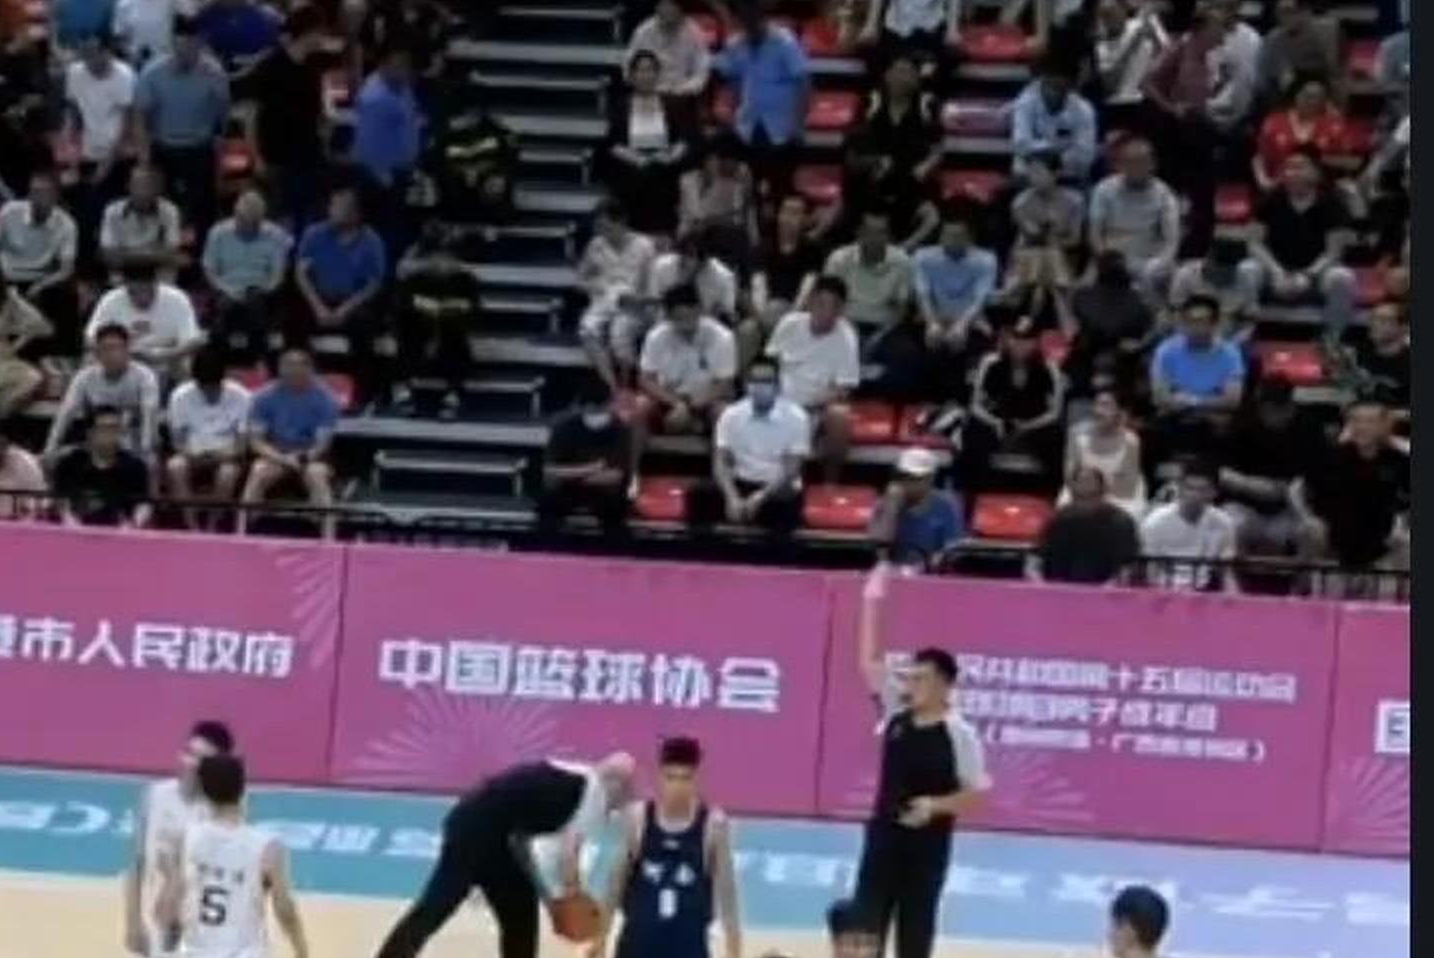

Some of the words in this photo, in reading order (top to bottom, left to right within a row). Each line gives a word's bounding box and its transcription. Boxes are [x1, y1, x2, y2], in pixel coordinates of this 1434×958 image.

[379, 638, 781, 713] 中国篮球协会
[198, 884, 229, 927] 5
